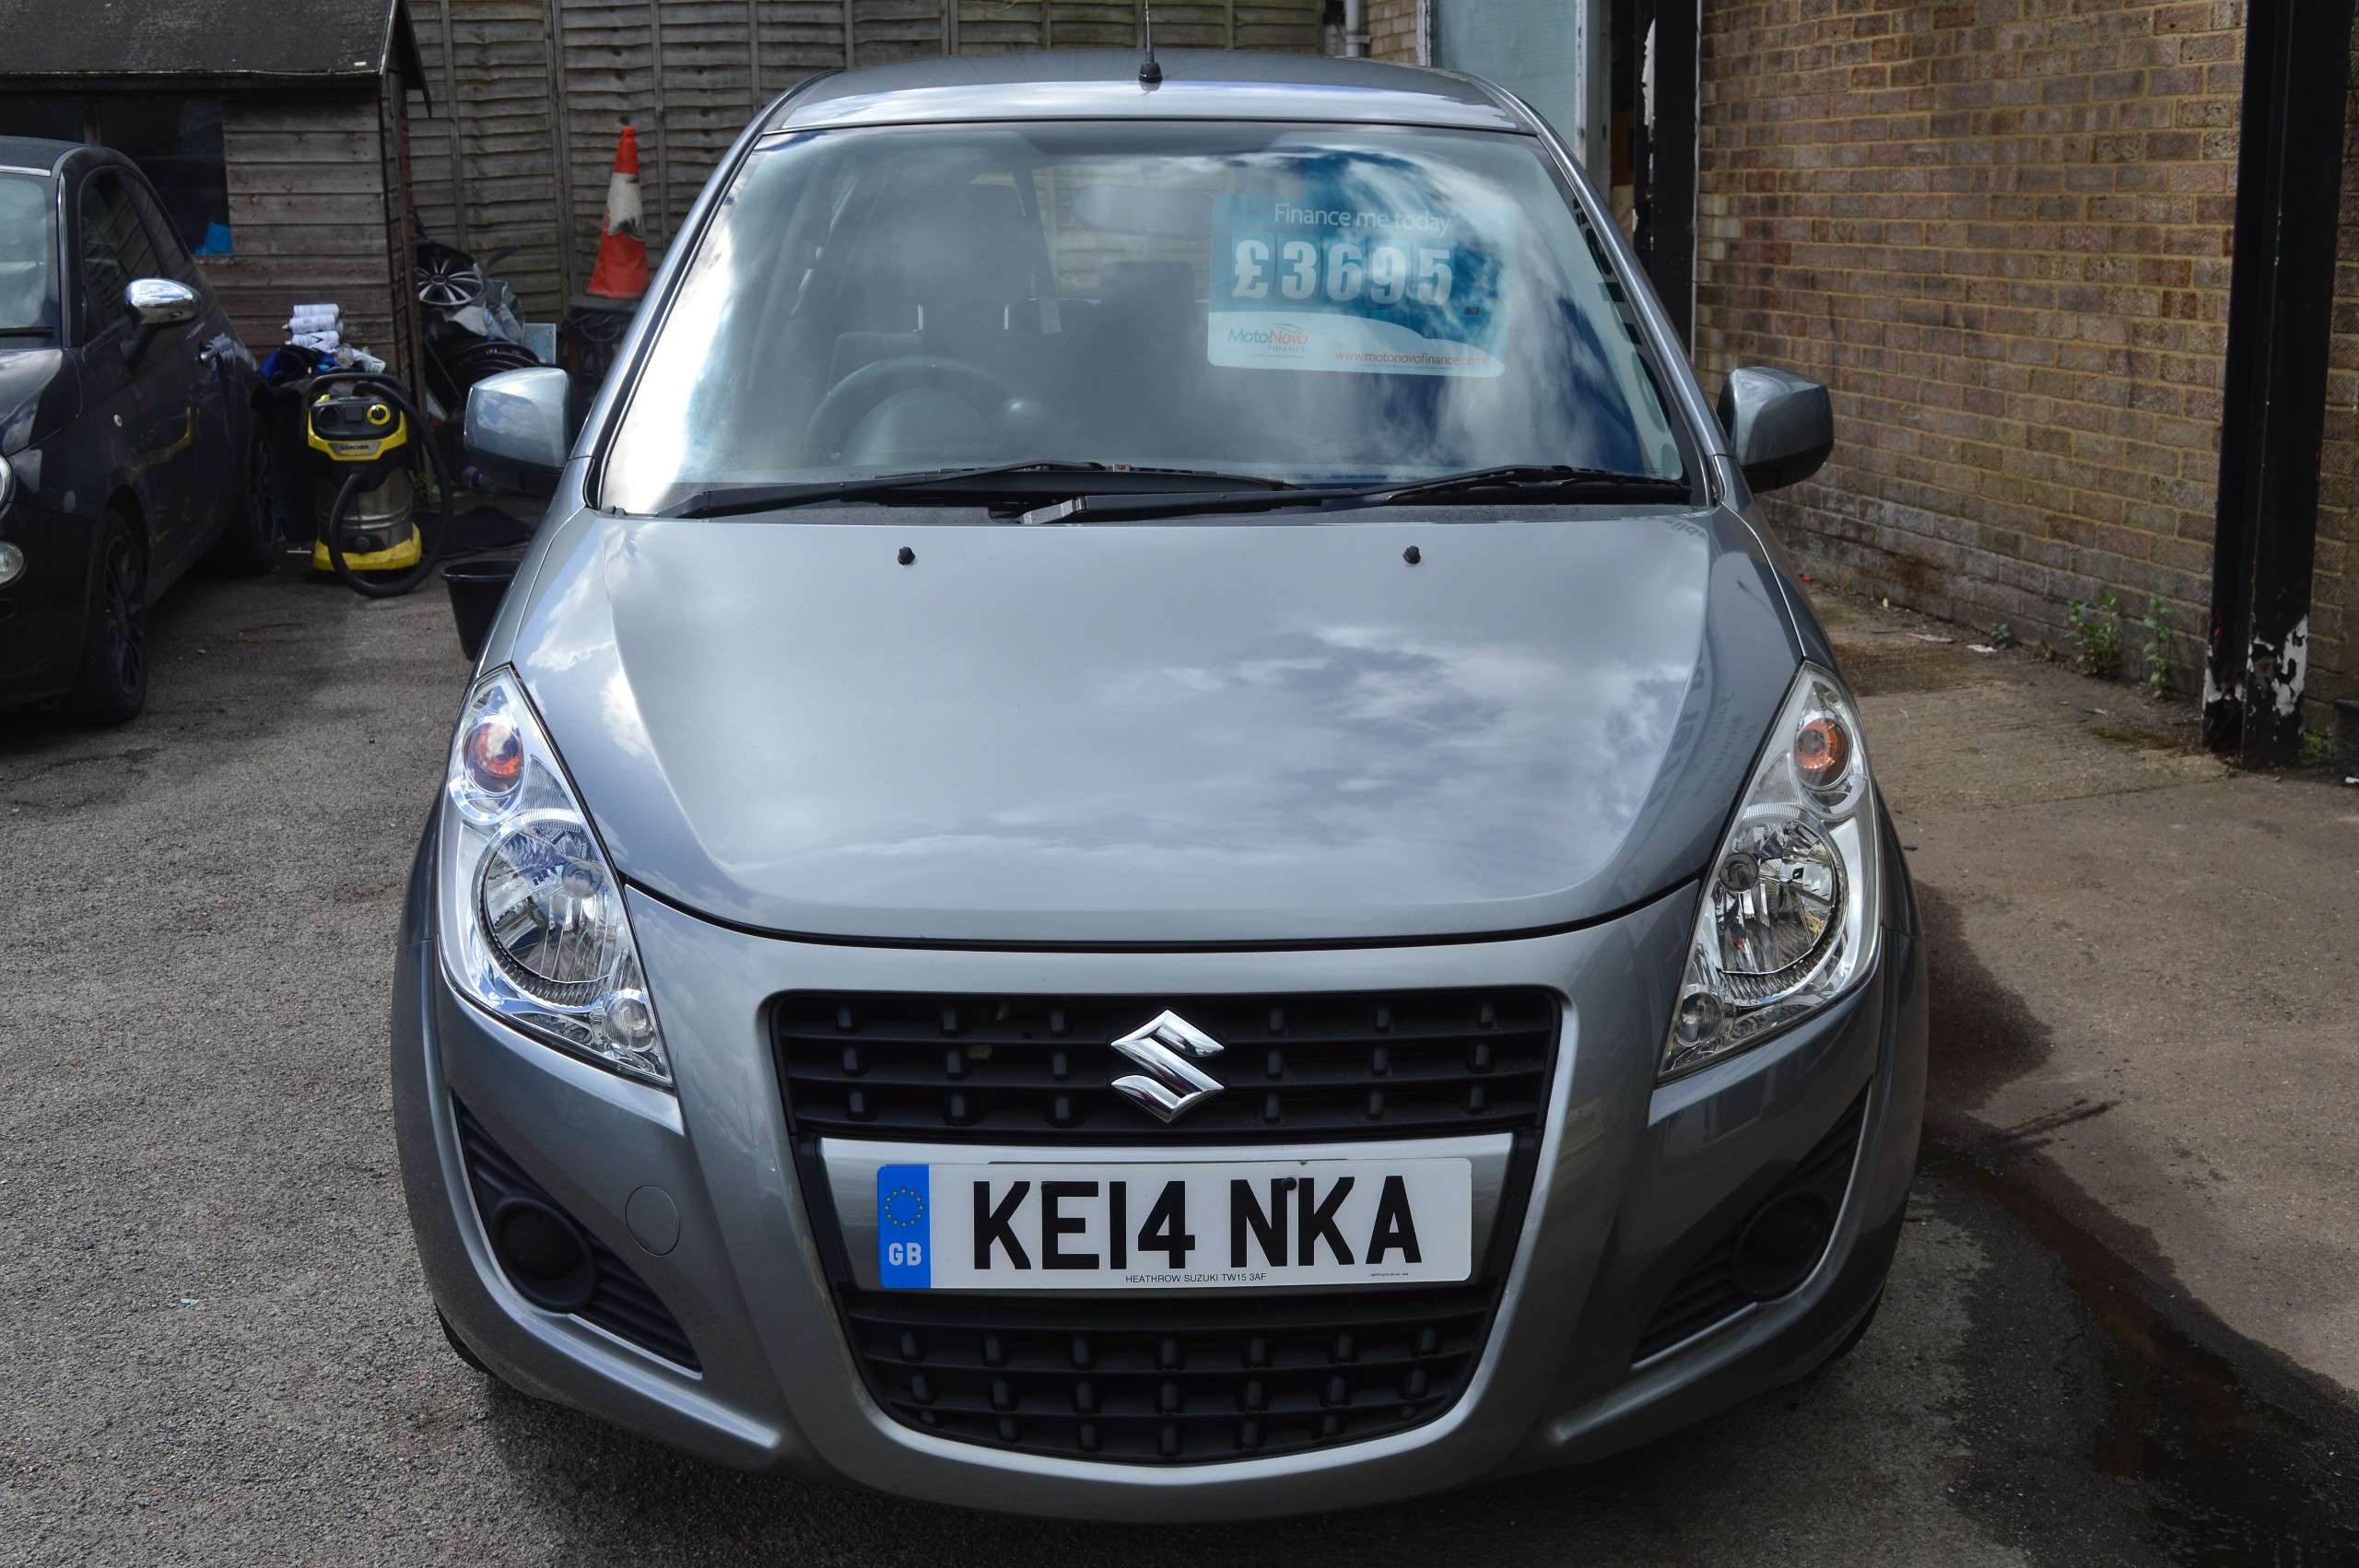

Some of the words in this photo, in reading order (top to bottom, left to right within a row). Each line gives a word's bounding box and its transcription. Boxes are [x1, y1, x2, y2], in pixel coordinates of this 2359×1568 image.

[1274, 203, 1351, 227] Finance
[1356, 212, 1391, 228] me
[1395, 213, 1452, 238] today
[1233, 240, 1453, 305] £3695
[1227, 328, 1309, 345] MotoNovo
[1268, 345, 1306, 355] FINANCE
[1335, 351, 1489, 367] www.motonovofinance.com
[973, 1180, 1196, 1270] KE14
[1230, 1176, 1422, 1267] NKA
[887, 1242, 922, 1267] GB
[1125, 1274, 1181, 1283] HEATHROW
[1184, 1274, 1219, 1282] SUZUKI
[1222, 1273, 1248, 1282] TW15
[1250, 1273, 1267, 1281] 3AF
